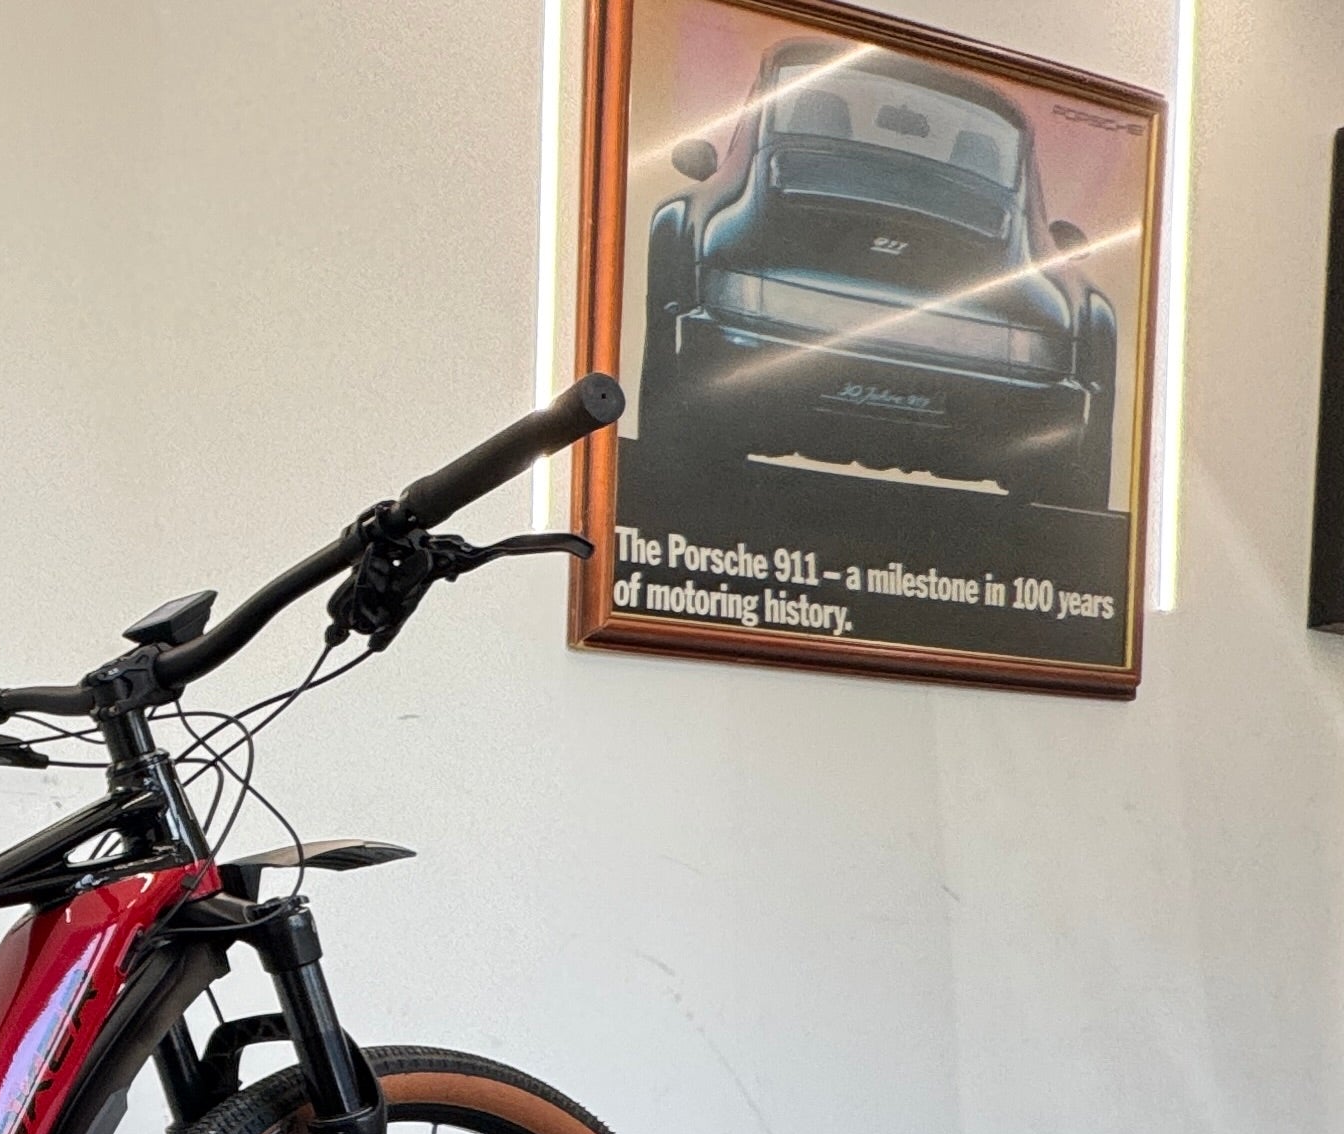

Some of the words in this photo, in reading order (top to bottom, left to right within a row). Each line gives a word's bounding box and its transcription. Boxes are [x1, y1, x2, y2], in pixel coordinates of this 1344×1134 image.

[613, 571, 642, 608] of
[646, 579, 760, 627] motoring
[764, 588, 853, 636] history.
[614, 525, 661, 566] The
[668, 533, 768, 579] Porsche
[773, 548, 819, 586] 911
[846, 564, 861, 591] a
[867, 561, 979, 604] milestone
[985, 573, 1006, 607] in
[1012, 577, 1053, 613] 100
[1056, 589, 1115, 620] years
